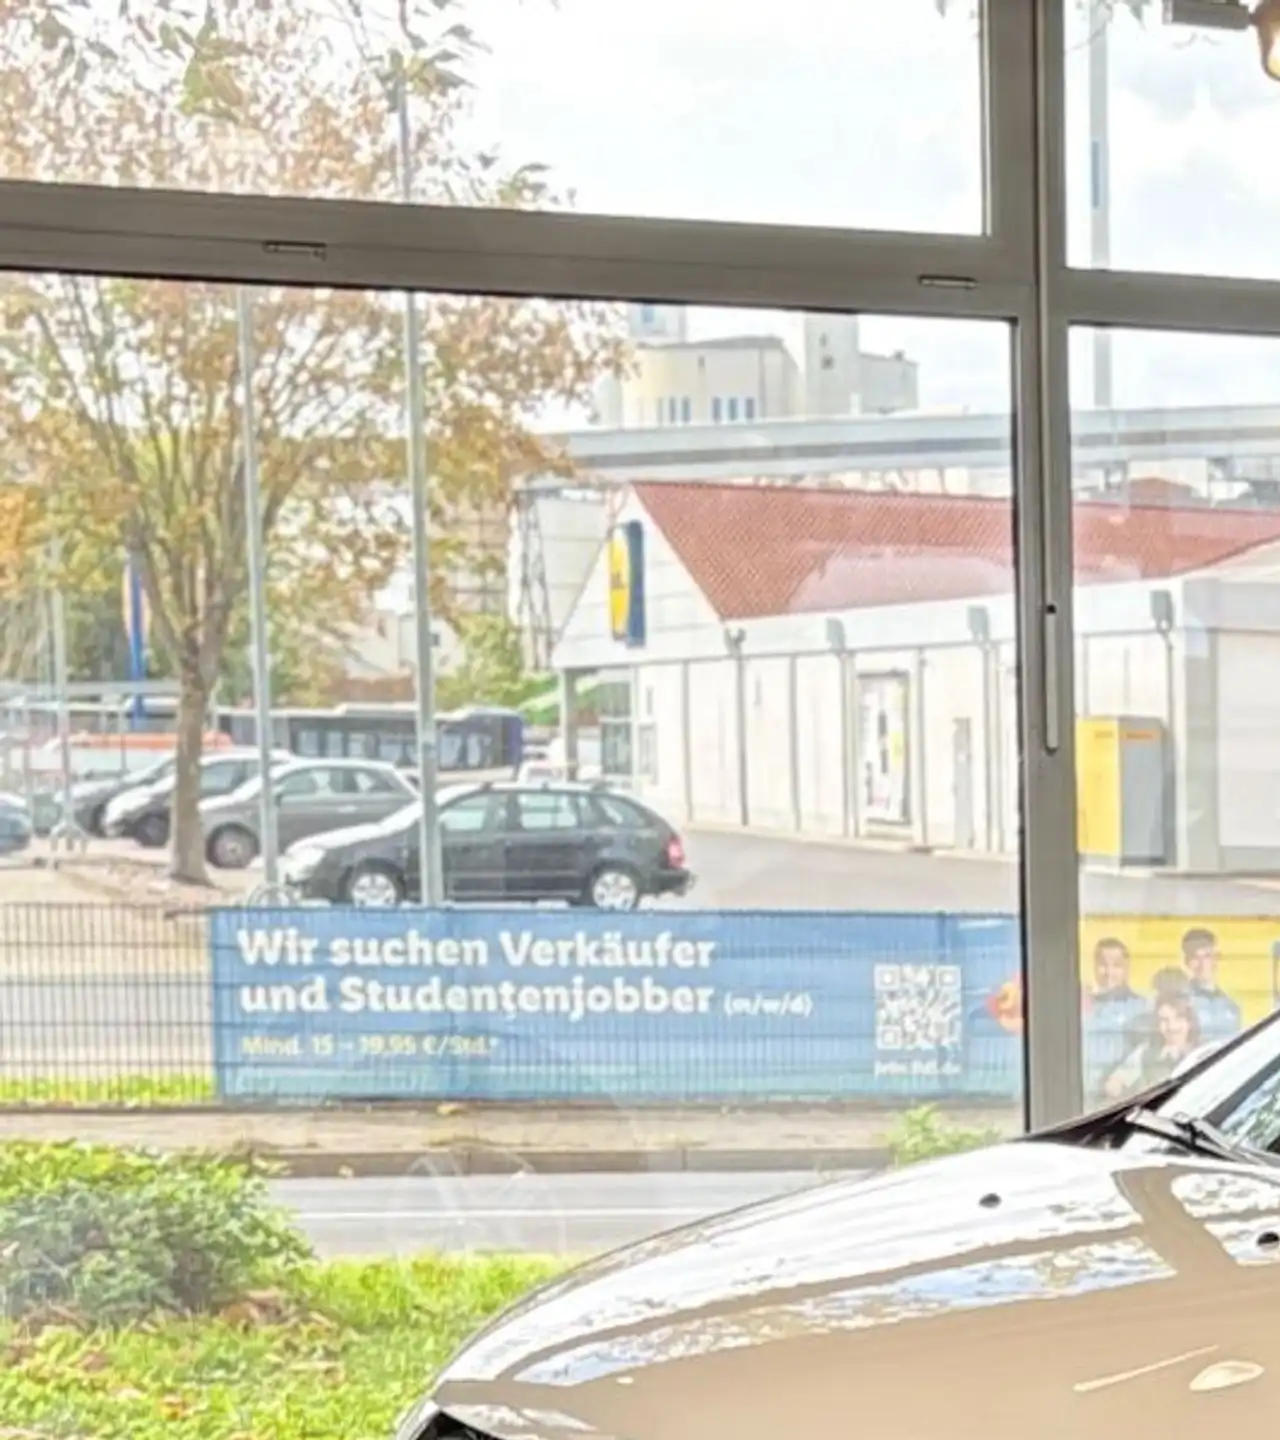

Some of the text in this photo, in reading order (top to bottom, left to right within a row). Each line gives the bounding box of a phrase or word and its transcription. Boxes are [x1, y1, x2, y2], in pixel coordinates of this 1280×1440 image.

[237, 929, 717, 969] Wir suchen Verkäufer
[240, 975, 328, 1013] und
[339, 976, 714, 1022] Studentenjobber
